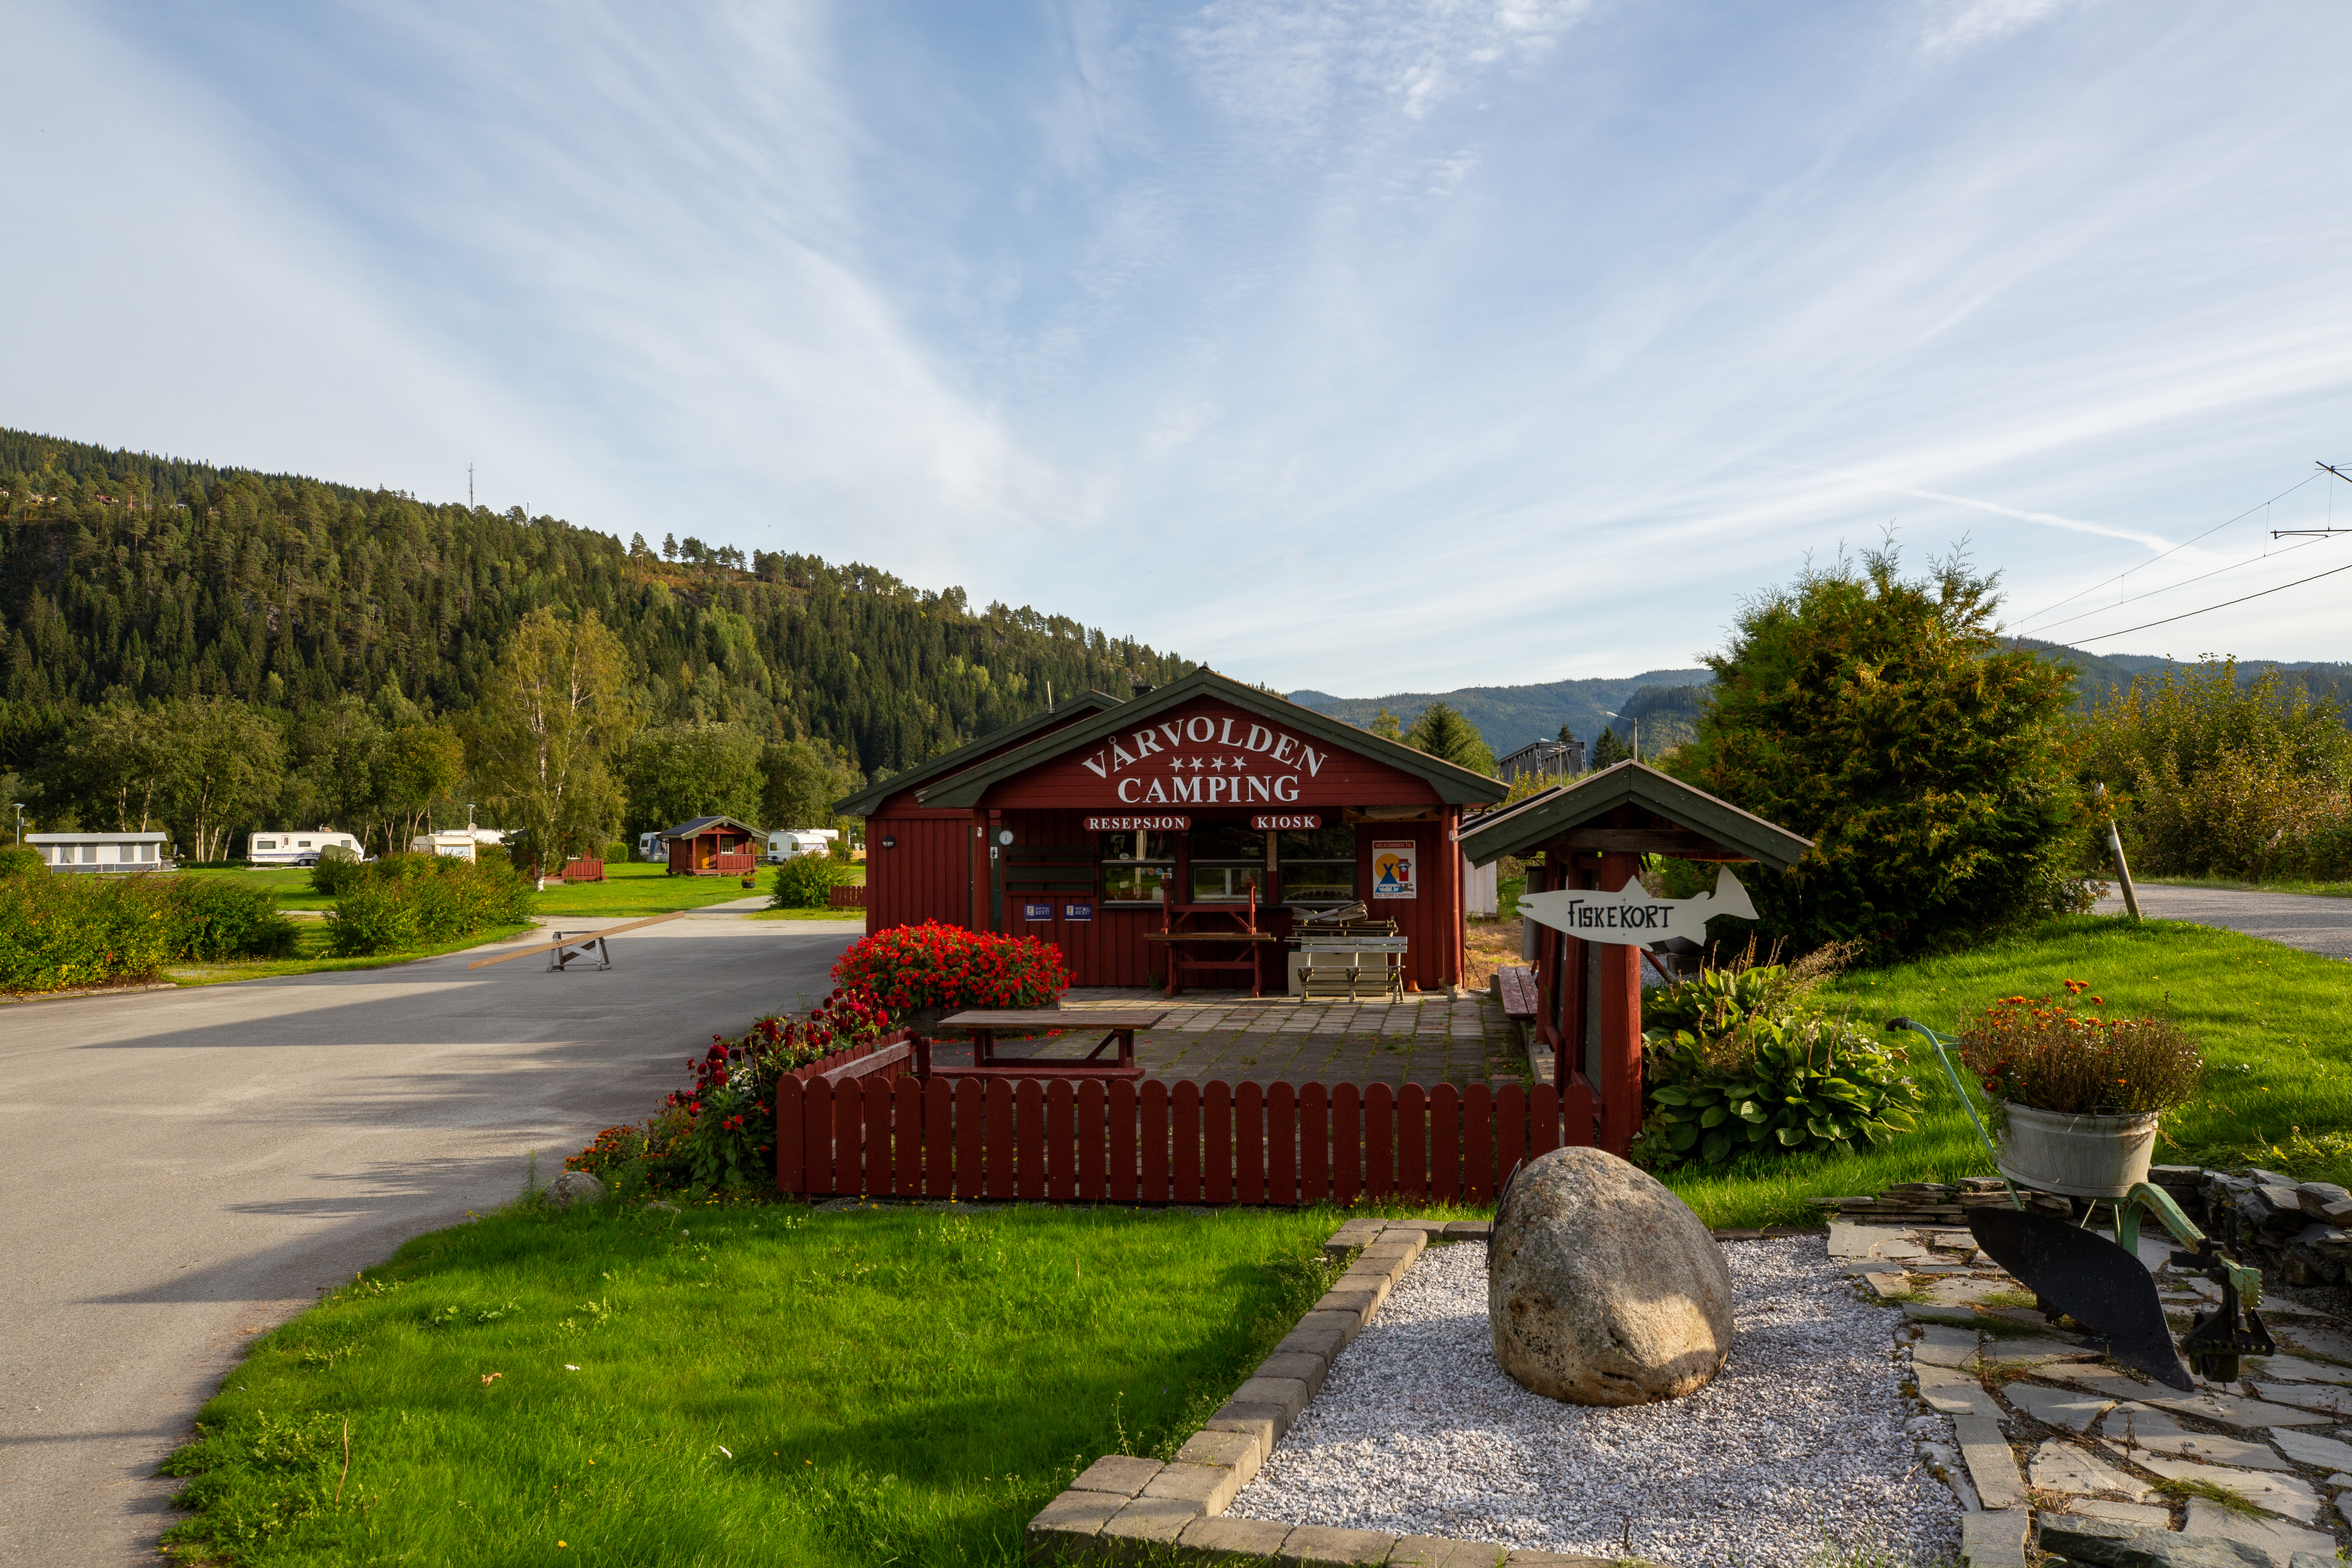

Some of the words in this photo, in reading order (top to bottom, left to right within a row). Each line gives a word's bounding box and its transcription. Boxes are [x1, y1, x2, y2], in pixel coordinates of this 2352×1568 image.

[1081, 717, 1328, 778] VÅRVOLDEN
[1118, 775, 1300, 803] CAMPING
[1089, 817, 1185, 829] RESEPSJON
[1257, 817, 1315, 828] KIOSK
[1568, 899, 1675, 929] FISKEKORT
[556, 938, 578, 946] STENGT
